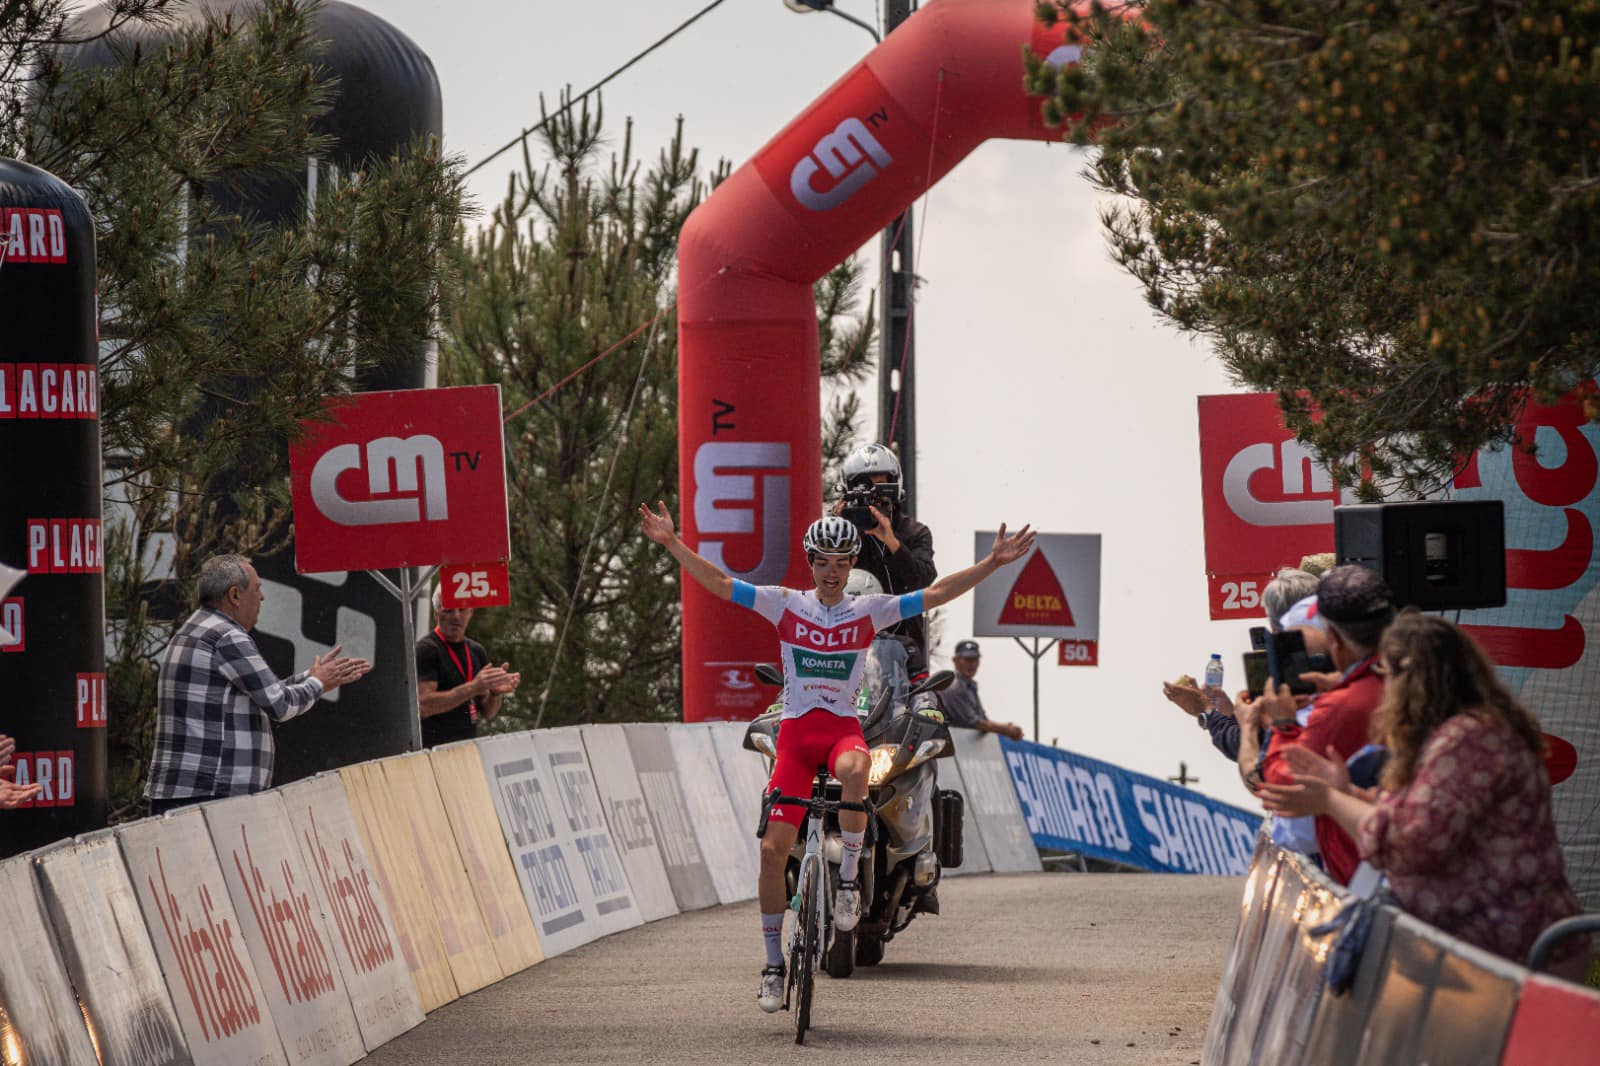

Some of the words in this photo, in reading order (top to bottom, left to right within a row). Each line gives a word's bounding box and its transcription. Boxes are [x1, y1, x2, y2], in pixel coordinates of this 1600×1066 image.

[866, 106, 888, 128] TV
[712, 398, 735, 436] TV
[450, 451, 481, 472] TV
[1013, 593, 1062, 611] DELTA
[795, 622, 858, 647] POLTI
[801, 656, 846, 670] KOMETA
[1006, 751, 1132, 851] SHIMANO
[233, 823, 336, 1006] Vitalis
[148, 846, 261, 1043] Vitalis
